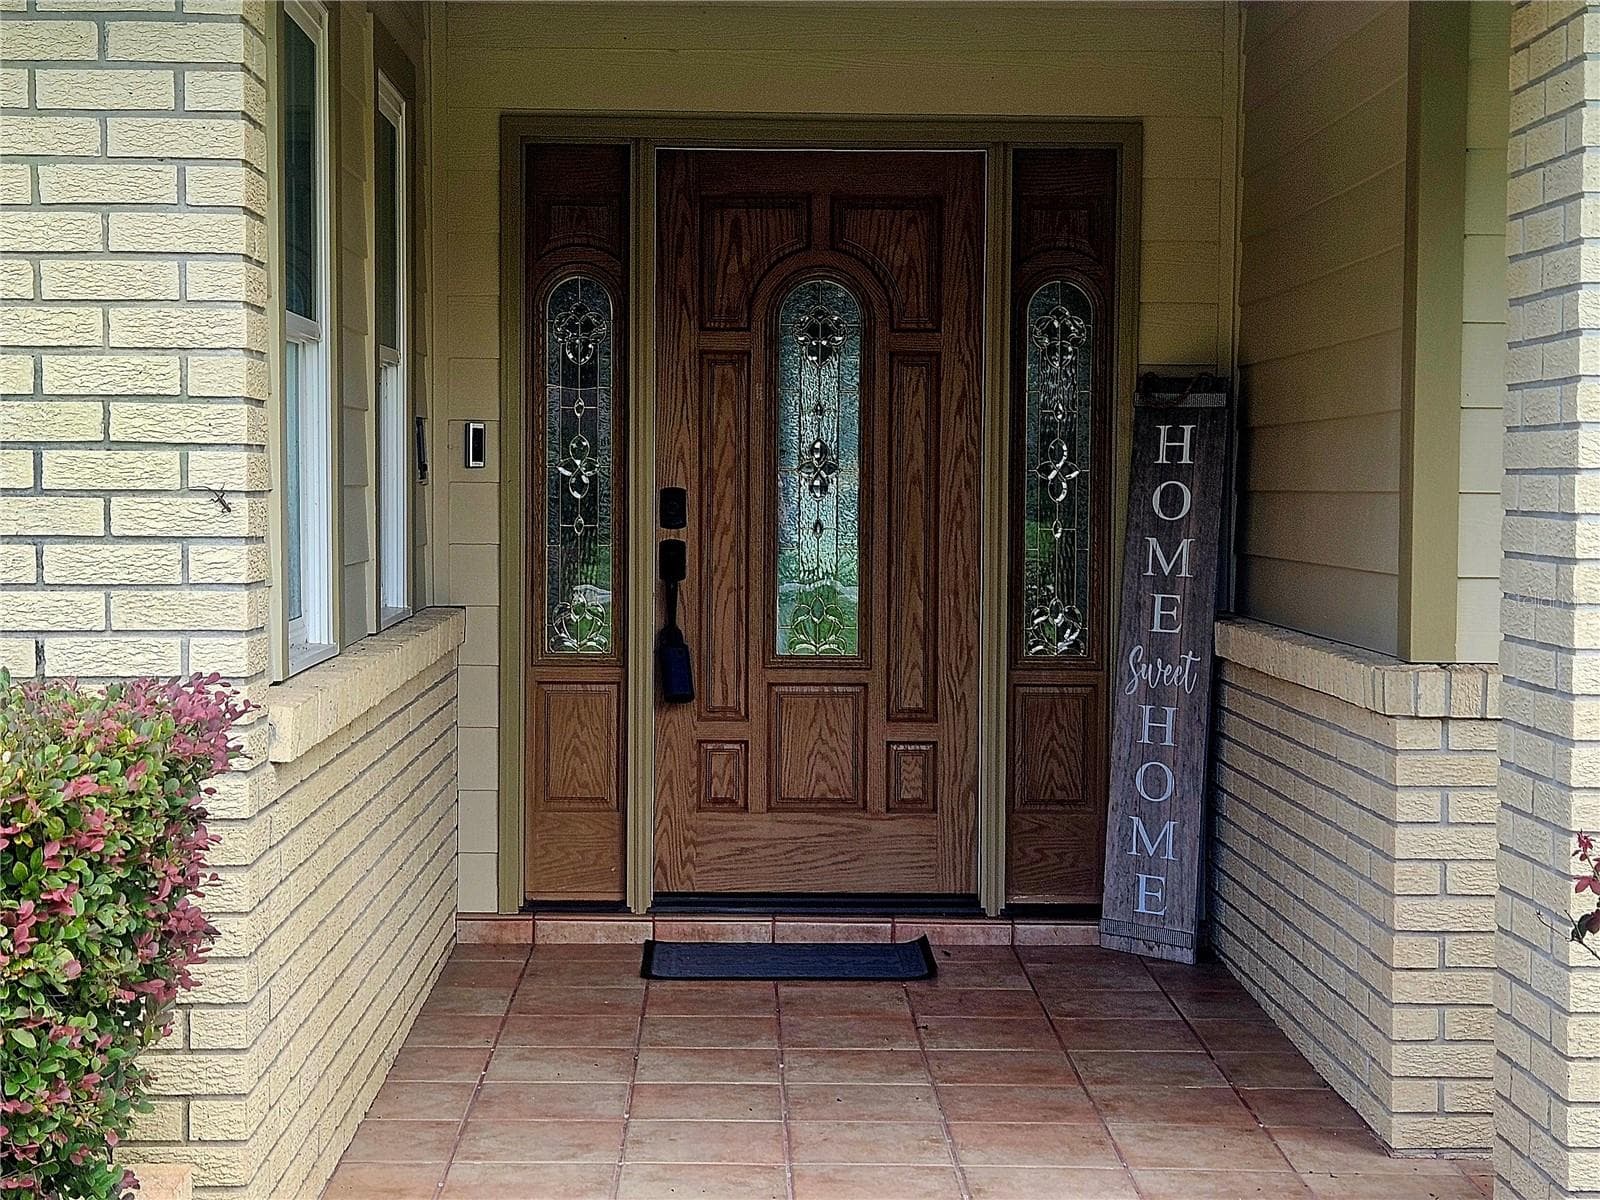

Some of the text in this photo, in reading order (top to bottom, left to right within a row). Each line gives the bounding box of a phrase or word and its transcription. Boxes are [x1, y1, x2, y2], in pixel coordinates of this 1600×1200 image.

[1143, 424, 1196, 634] HOME
[1125, 645, 1201, 695] Sweet
[1127, 704, 1179, 916] HOME
